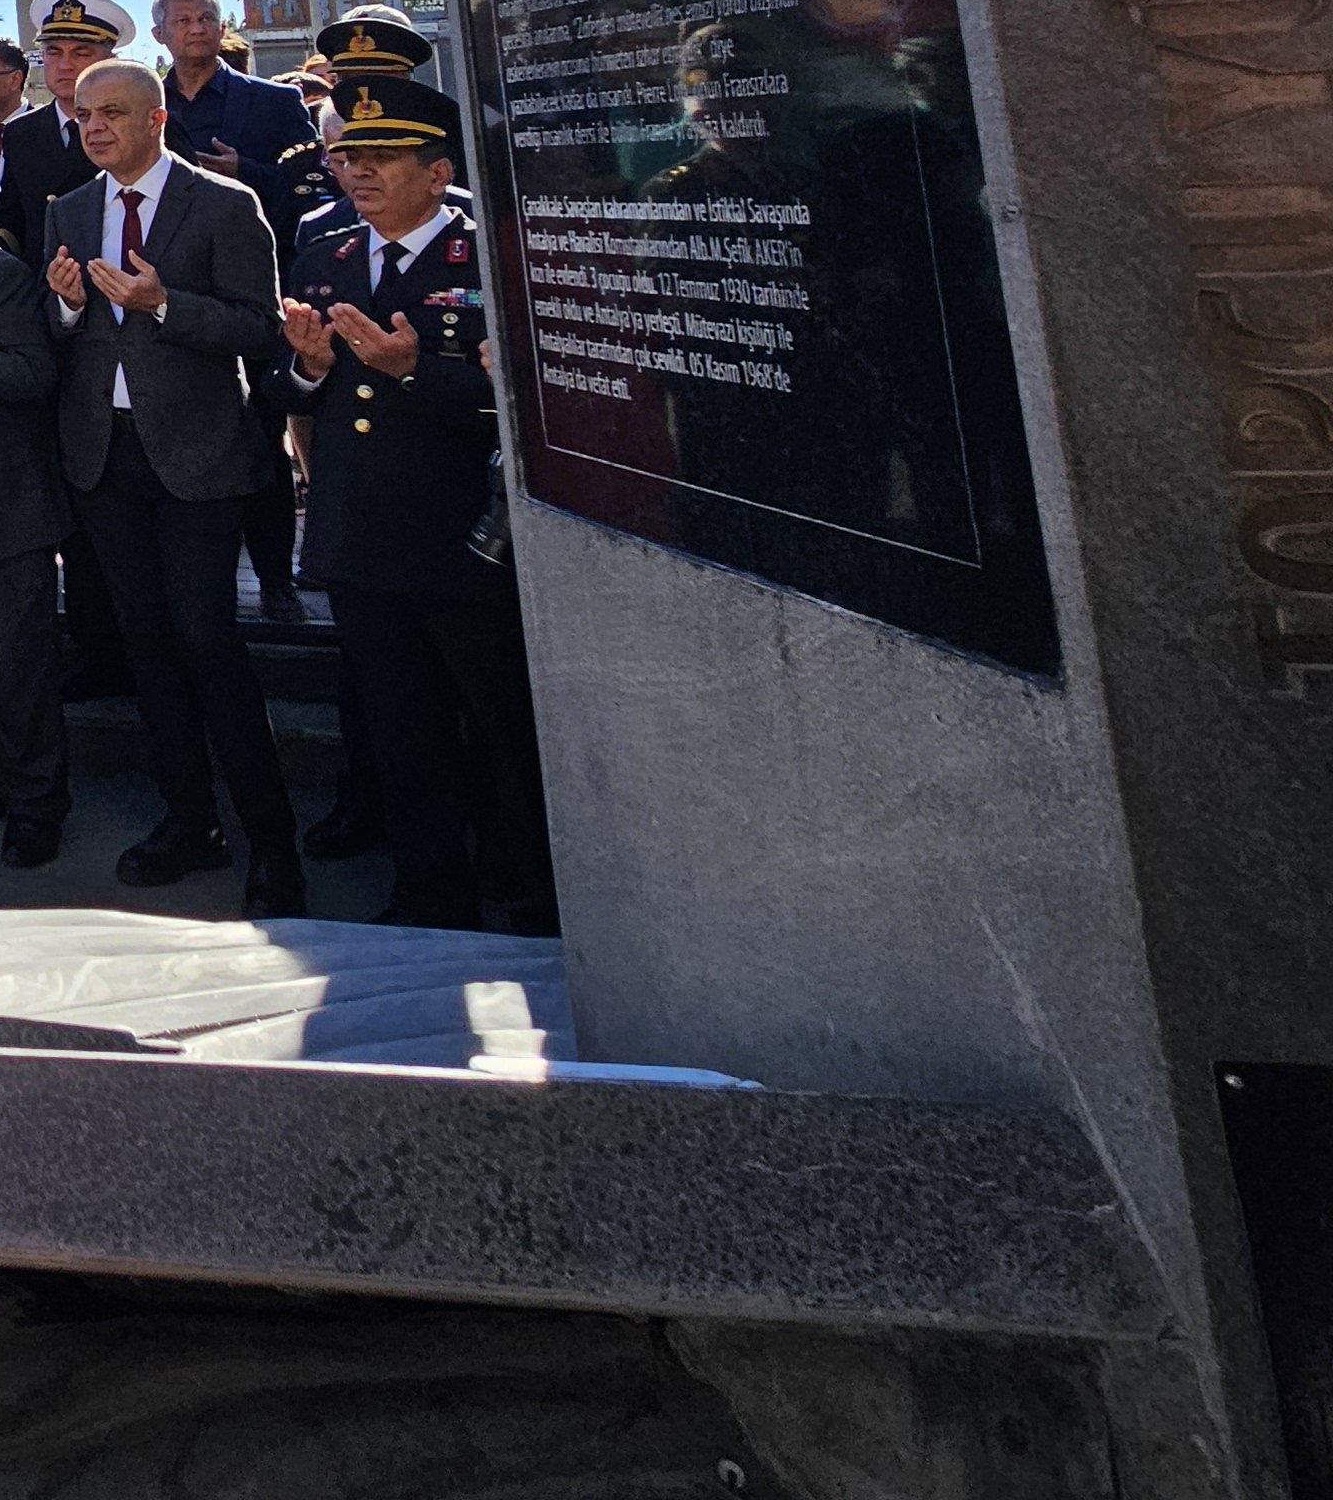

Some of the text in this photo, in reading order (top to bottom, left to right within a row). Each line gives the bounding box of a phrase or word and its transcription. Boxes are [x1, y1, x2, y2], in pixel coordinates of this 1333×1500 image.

[636, 80, 667, 105] Pierre
[723, 68, 789, 99] Fransızlara
[719, 110, 770, 139] kaldırdı.
[522, 195, 563, 222] Çanakkale
[601, 195, 692, 220] kahramanlarından
[692, 202, 707, 221] ve
[706, 193, 747, 223] İstiklal
[747, 197, 811, 231] Savaşında
[526, 228, 558, 256] Antalya
[603, 231, 689, 259] Komutanlarından
[755, 238, 803, 267] AKER'in
[657, 272, 672, 296] 12
[672, 273, 720, 301] Temmuz
[721, 277, 751, 304] 1930
[751, 281, 810, 311] tarihinde
[643, 307, 685, 340] yerleşti.
[684, 311, 736, 343] Mütevazi
[735, 317, 776, 355] kişiliği
[776, 322, 794, 350] ile
[587, 371, 612, 397] vefat
[611, 377, 632, 400] etti.
[634, 343, 653, 373] çok
[652, 347, 689, 374] sevildi.
[688, 351, 705, 377] 05
[704, 353, 741, 384] Kasım
[740, 360, 792, 393] 1968'de
